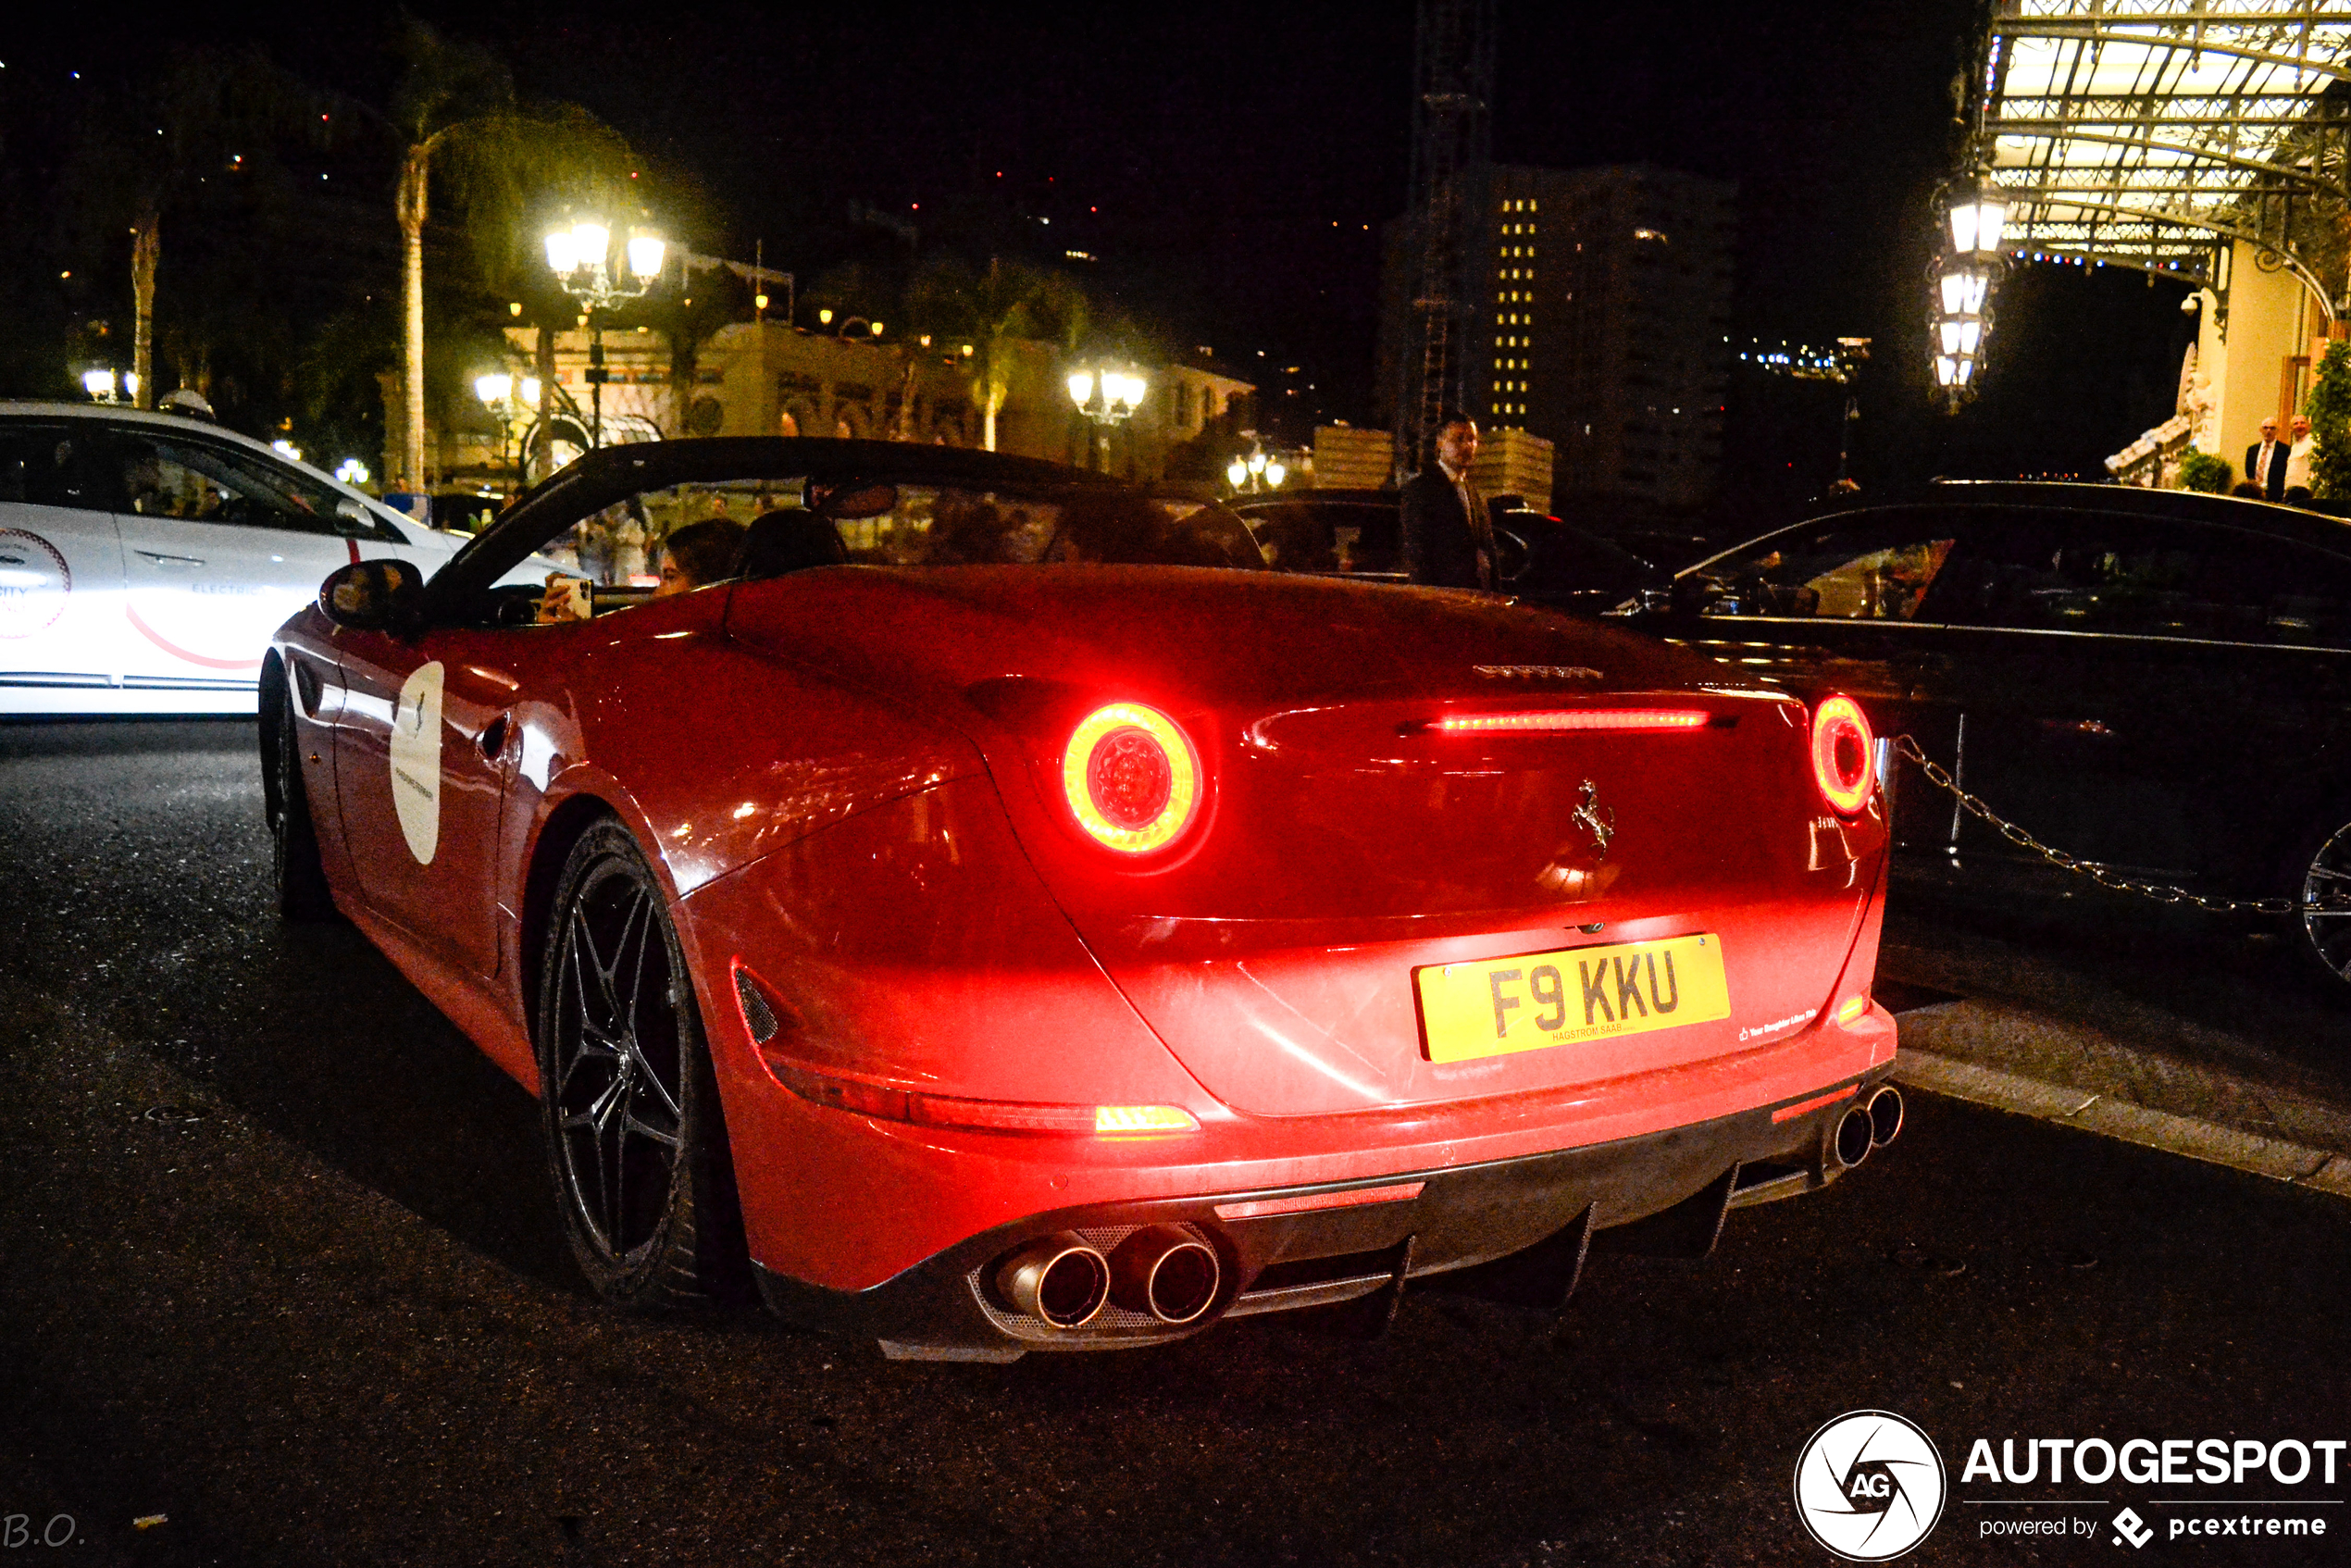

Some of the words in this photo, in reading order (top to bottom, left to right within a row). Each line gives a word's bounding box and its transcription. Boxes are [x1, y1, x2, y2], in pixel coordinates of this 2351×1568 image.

[1489, 964, 1566, 1039] F9
[1578, 950, 1679, 1027] KKU
[1552, 1027, 1599, 1041] HAGSTROM
[1600, 1024, 1623, 1034] SAAB
[1749, 1027, 1763, 1037] Your
[1764, 1019, 1790, 1032] Daughter
[1790, 1014, 1805, 1024] Likes
[1806, 1009, 1816, 1019] This
